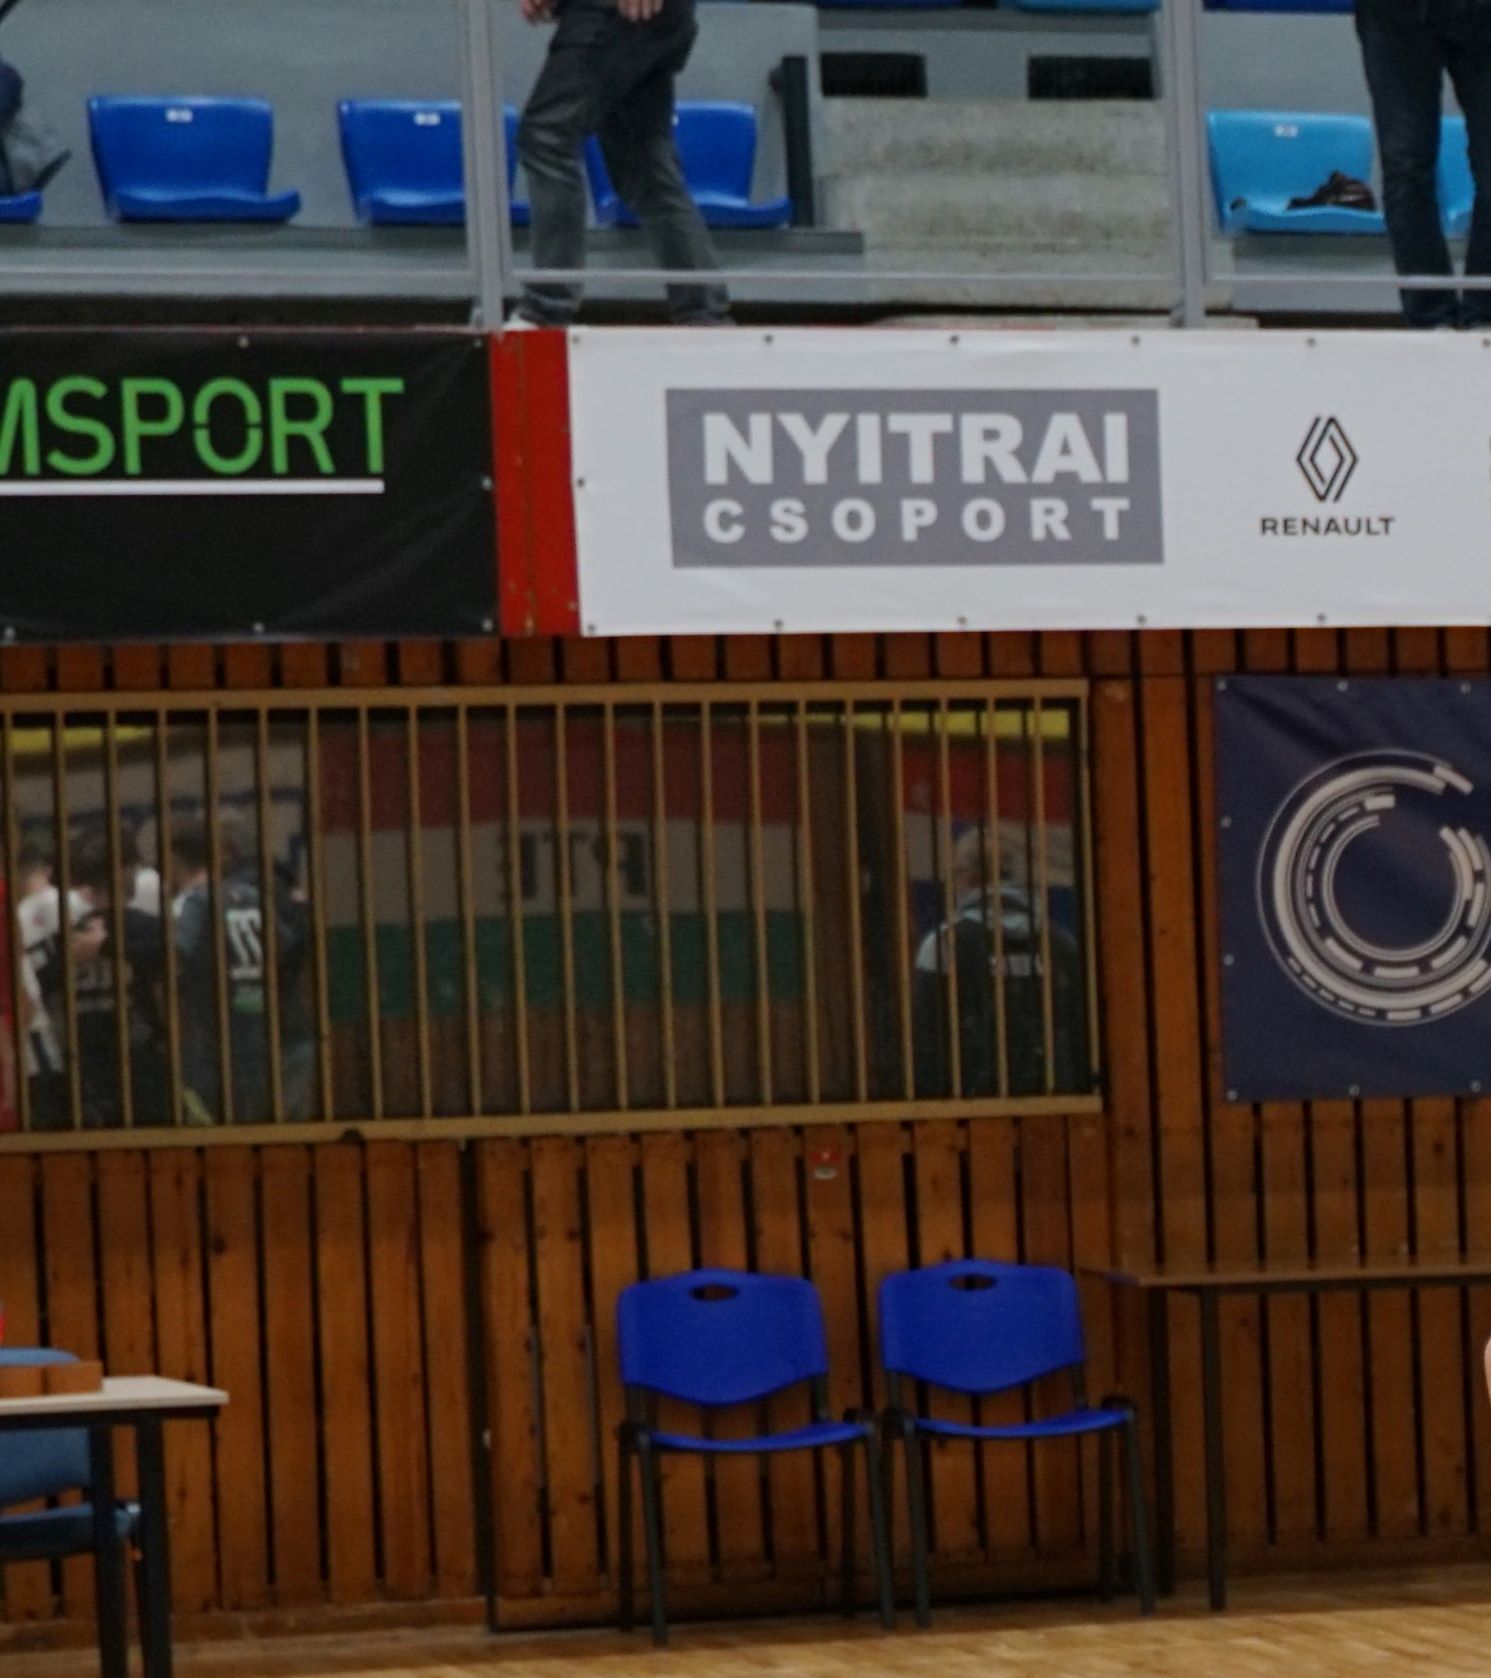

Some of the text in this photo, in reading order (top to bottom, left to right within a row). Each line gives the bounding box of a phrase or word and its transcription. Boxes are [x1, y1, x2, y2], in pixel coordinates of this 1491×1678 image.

[704, 412, 1130, 485] NYITRAI
[703, 497, 1132, 543] CSOPORT
[1261, 516, 1393, 536] RENAULT
